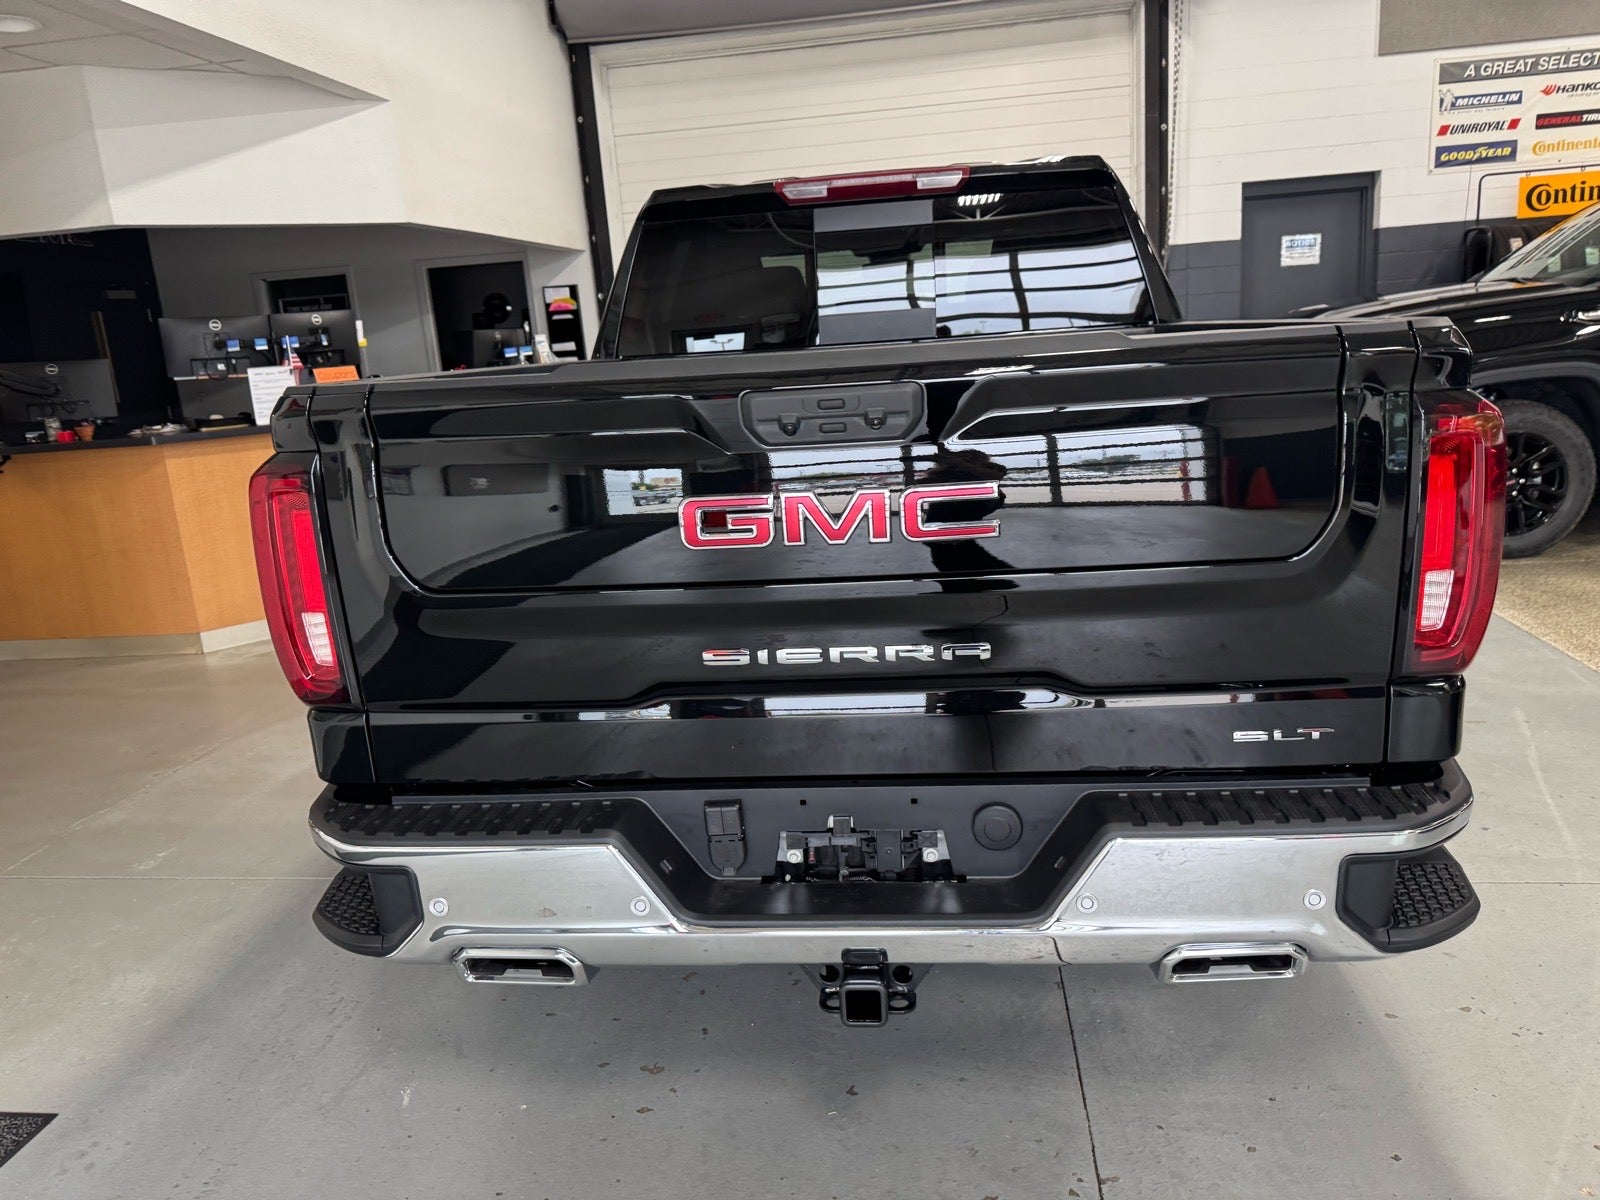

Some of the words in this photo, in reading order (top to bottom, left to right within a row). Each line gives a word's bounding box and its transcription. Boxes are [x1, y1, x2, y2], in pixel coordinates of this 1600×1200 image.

[1463, 64, 1476, 78] A
[1480, 58, 1536, 76] GREAT
[1538, 52, 1600, 71] SELECT
[1455, 93, 1520, 106] MICHELIN
[1449, 120, 1508, 135] UNIROYAL
[1440, 146, 1512, 161] GOODYEAR
[1532, 137, 1600, 156] Continent
[1525, 180, 1600, 212] Contin
[678, 481, 1000, 550] GMC
[702, 641, 992, 666] SIERRA
[1232, 727, 1335, 742] SLT
